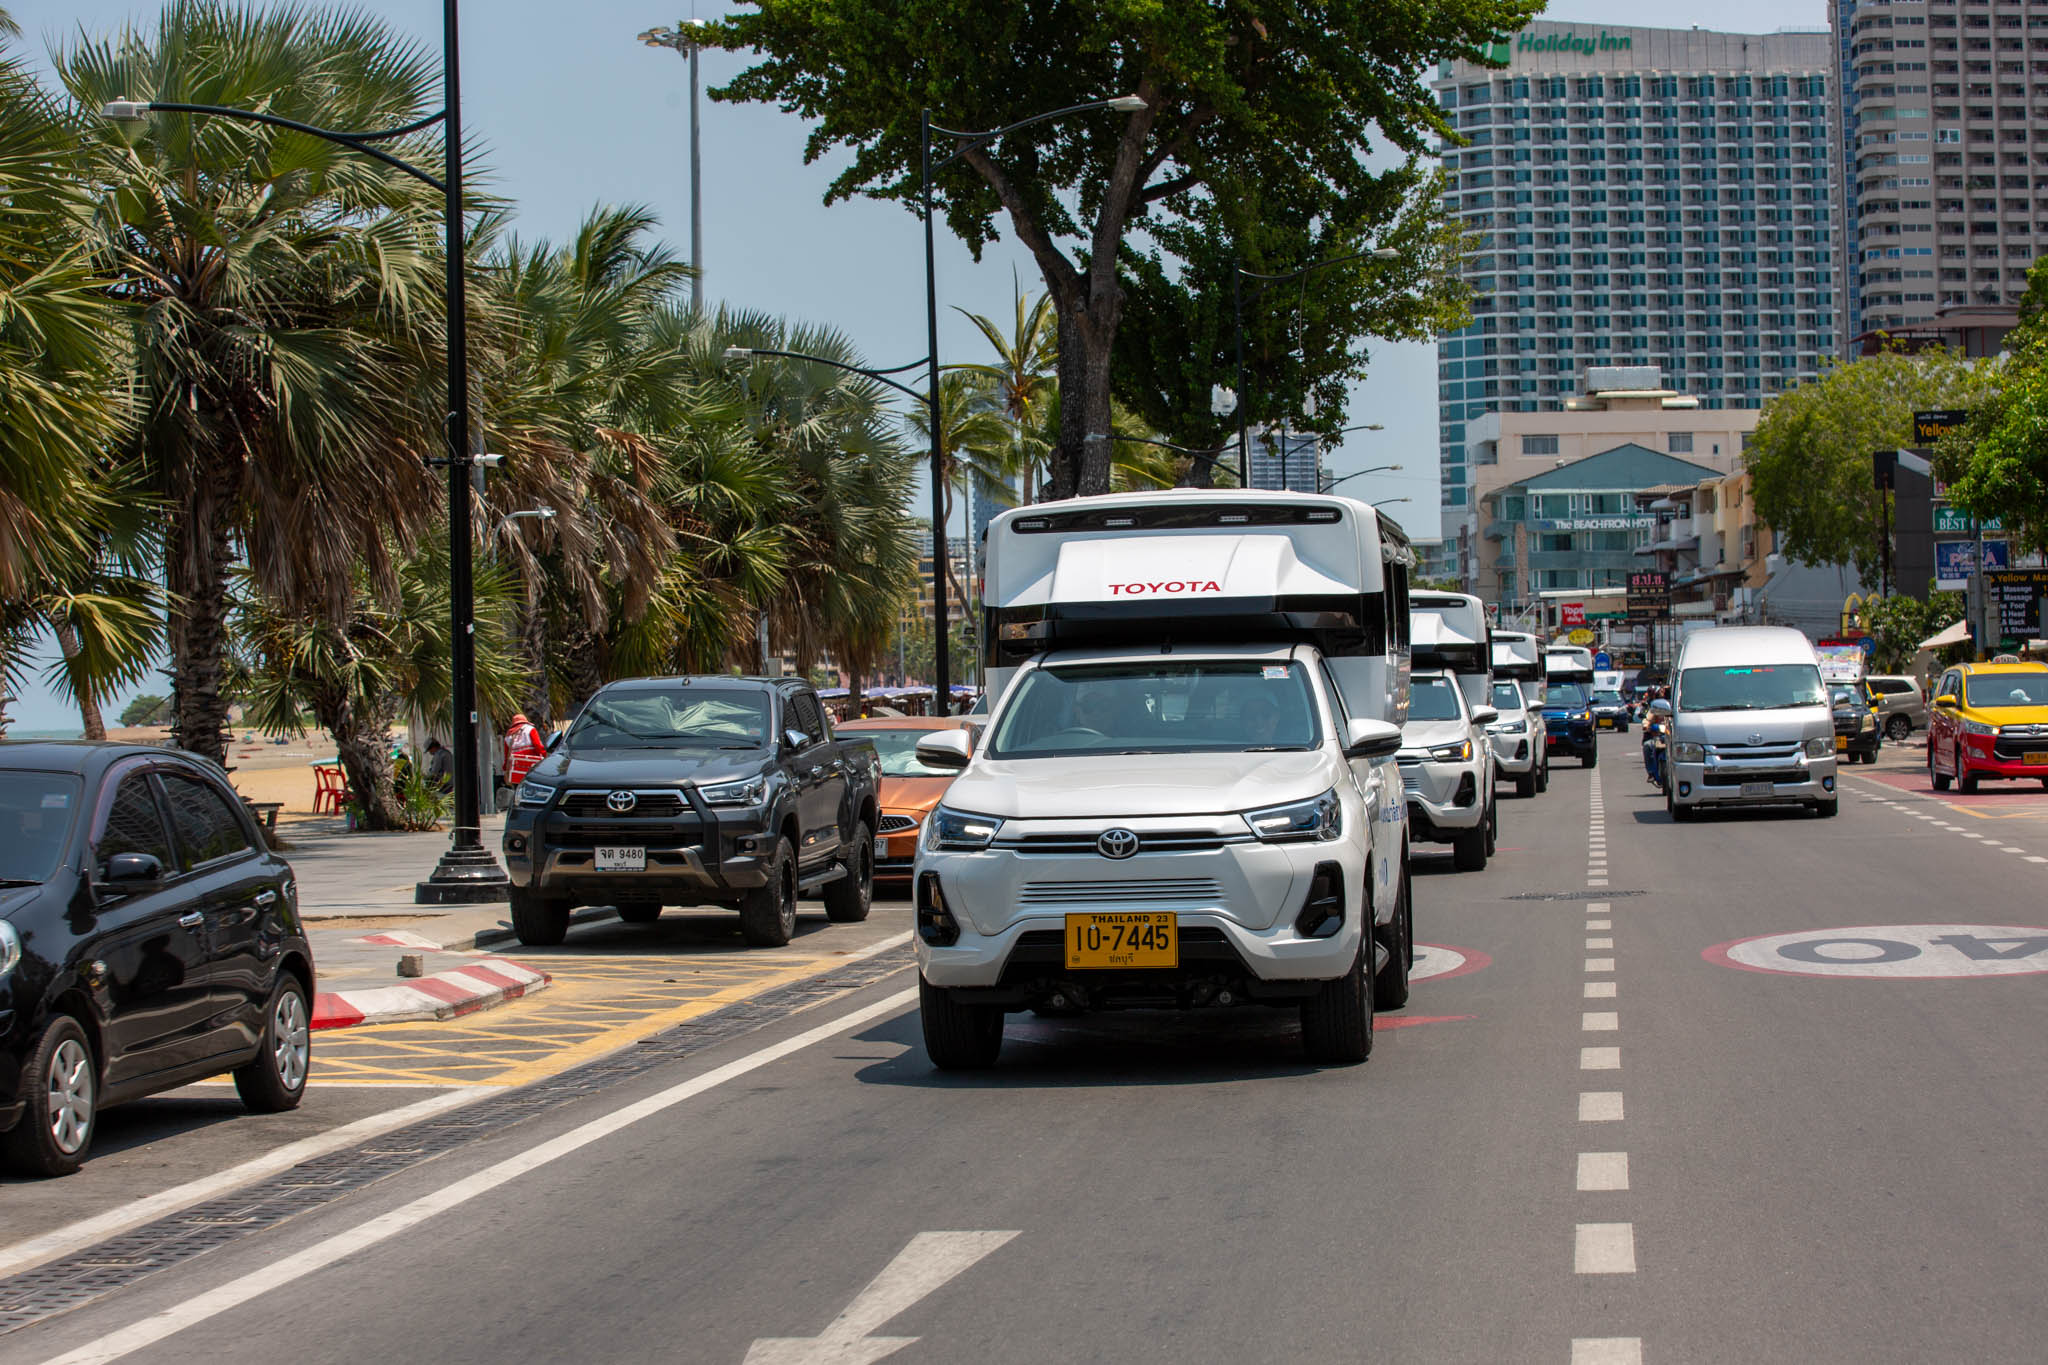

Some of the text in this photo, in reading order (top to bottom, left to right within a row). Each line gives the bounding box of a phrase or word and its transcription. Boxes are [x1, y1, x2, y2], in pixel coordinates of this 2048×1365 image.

[1518, 30, 1631, 55] Holiday Inn
[1555, 521, 1572, 530] The
[1939, 517, 1966, 530] BEST
[1997, 573, 2028, 583] Yellow
[1108, 581, 1221, 595] TOYOTA
[2003, 585, 2033, 594] Massage
[2003, 594, 2033, 602] Massage
[619, 849, 643, 859] 9480
[1091, 915, 1168, 923] THAILAND 23
[1076, 925, 1169, 951] 10-7445
